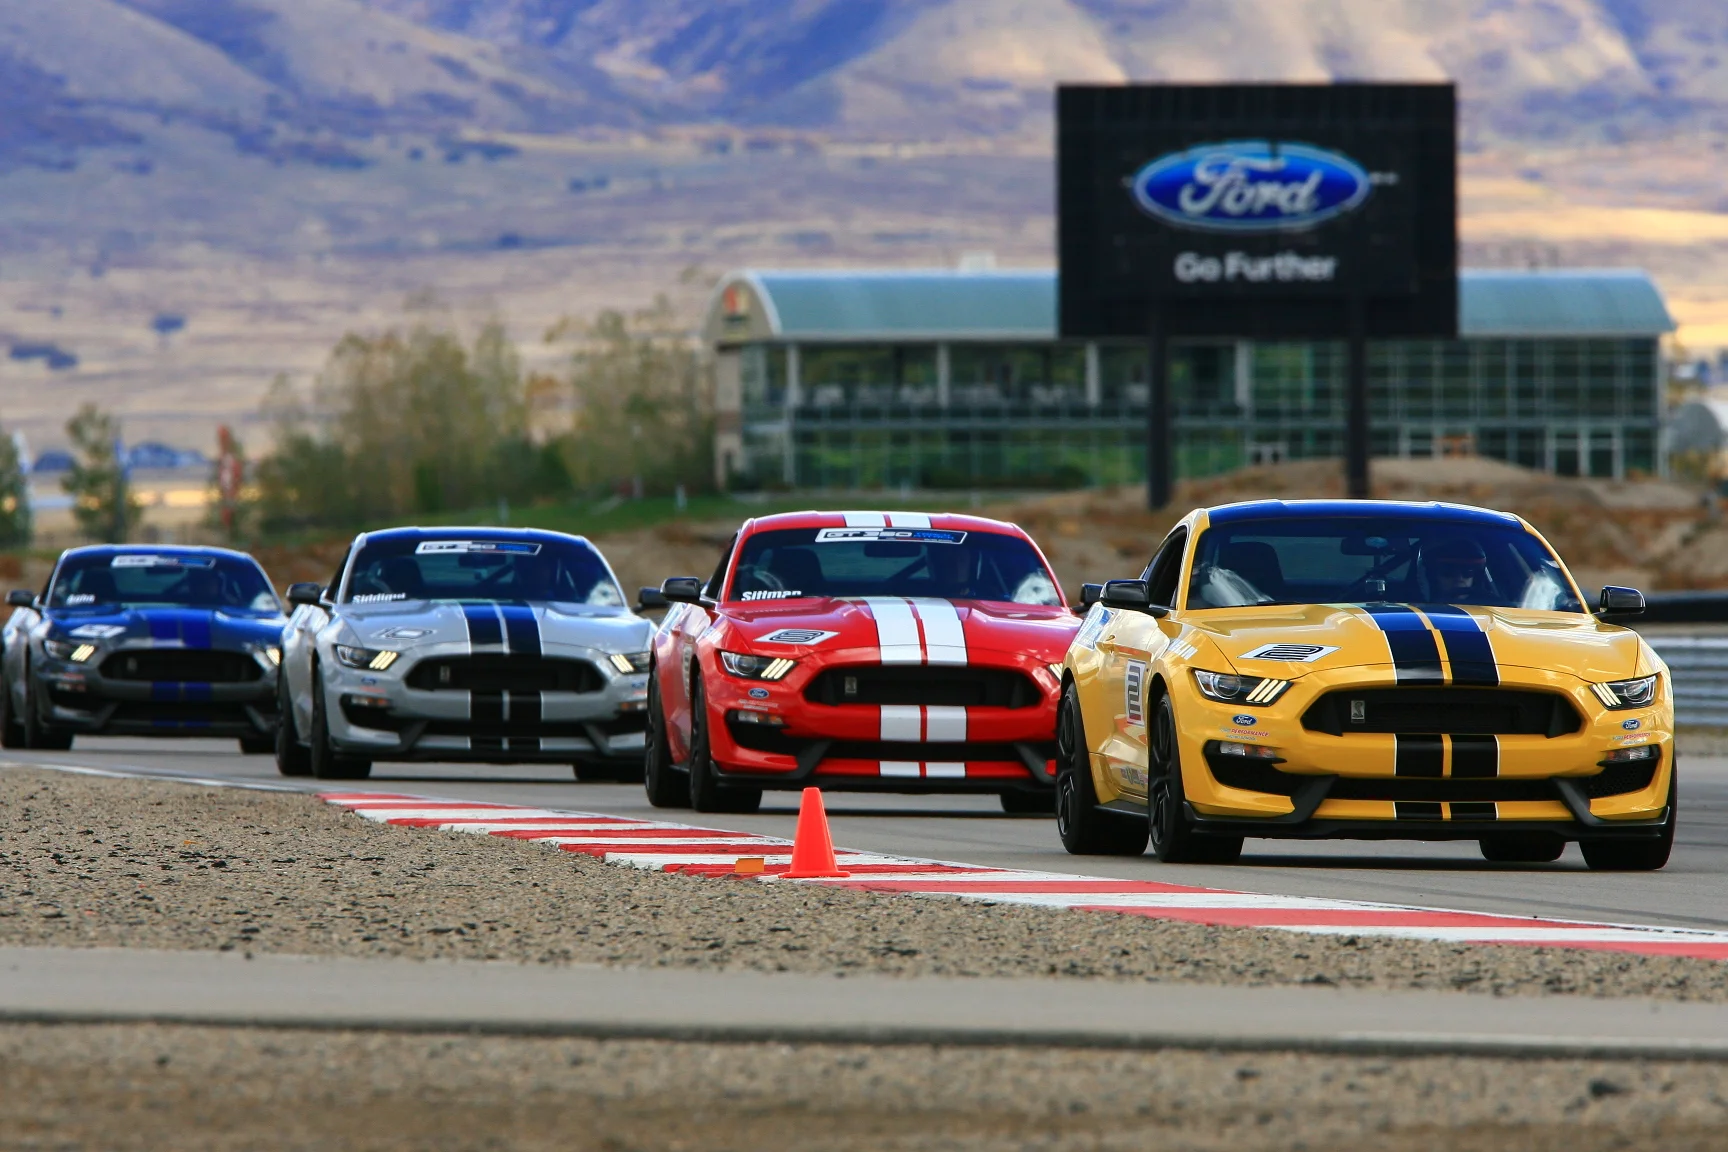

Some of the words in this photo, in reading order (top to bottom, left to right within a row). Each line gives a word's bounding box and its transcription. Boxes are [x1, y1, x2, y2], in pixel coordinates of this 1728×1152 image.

[1178, 153, 1323, 216] Ford
[1174, 252, 1221, 282] Go
[1224, 251, 1337, 282] Further
